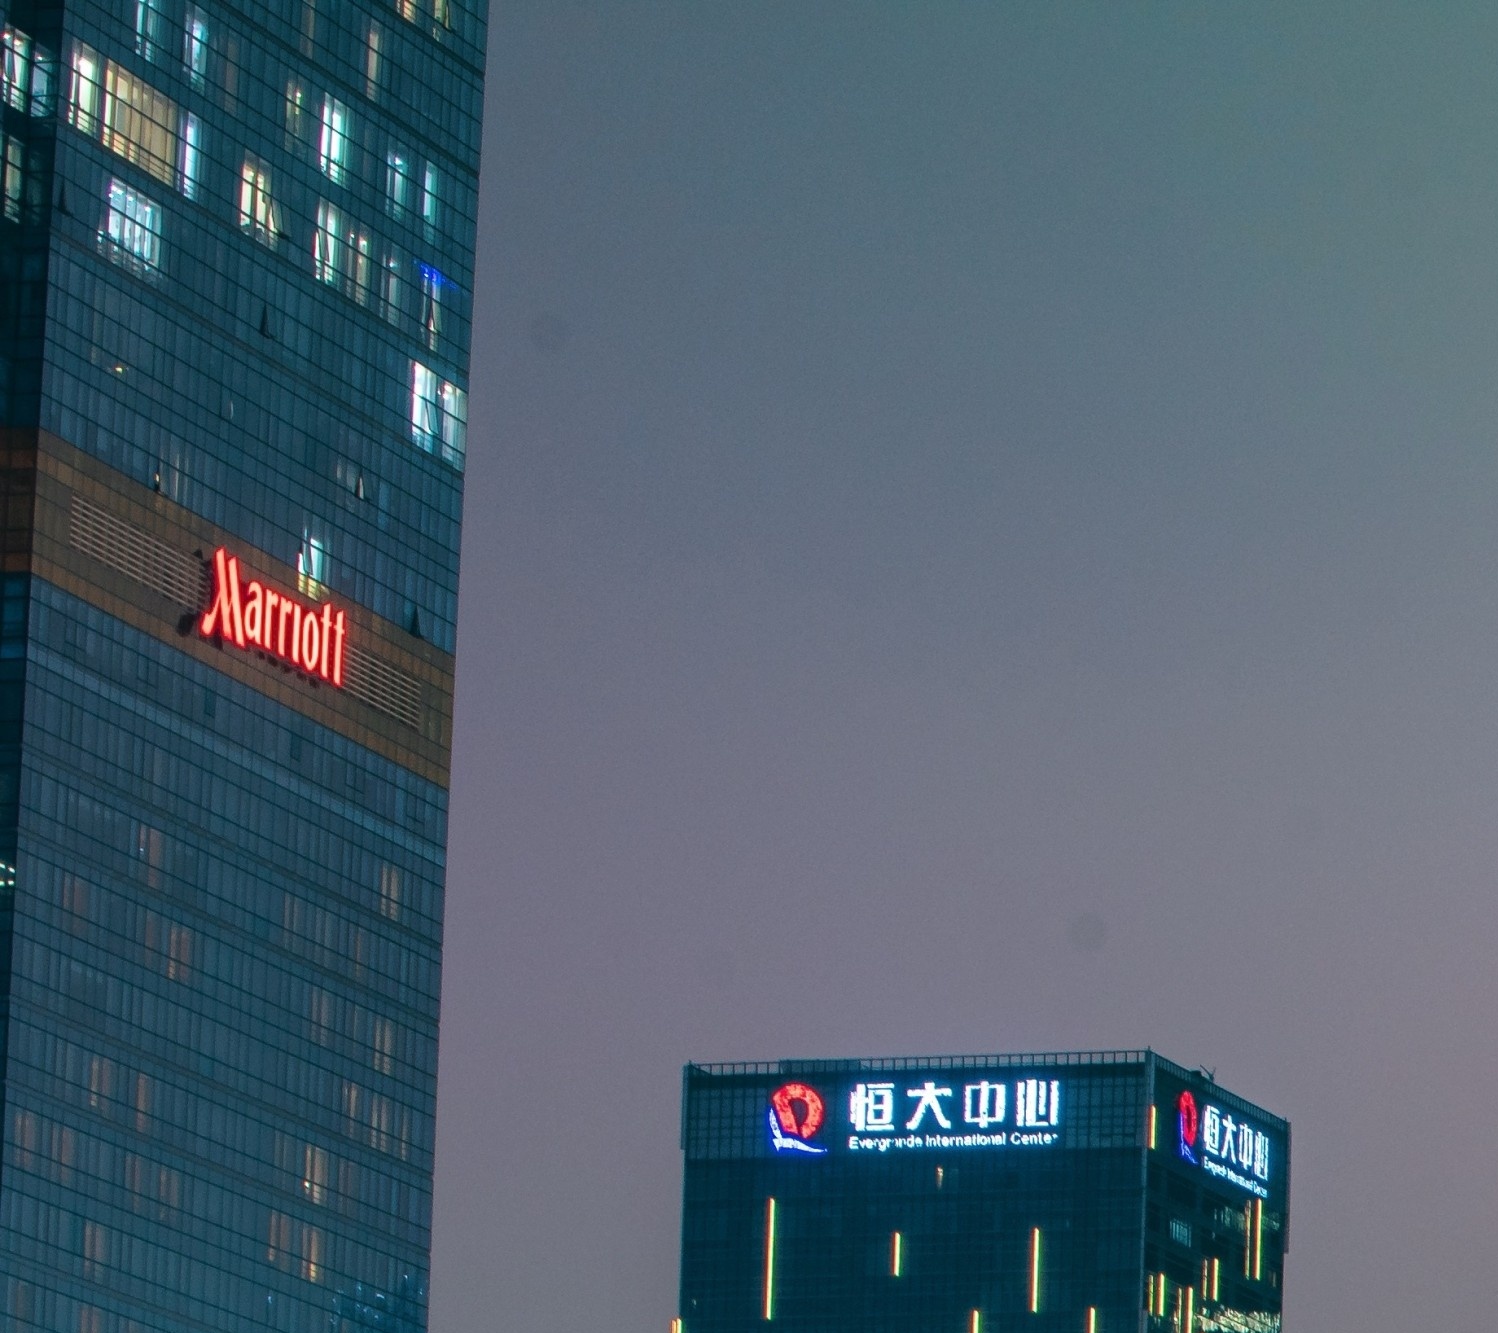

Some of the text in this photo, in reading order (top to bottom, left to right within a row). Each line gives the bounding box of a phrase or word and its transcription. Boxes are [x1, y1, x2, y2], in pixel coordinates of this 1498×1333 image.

[202, 547, 346, 687] Marriott
[850, 1079, 1060, 1131] 恒大中心
[849, 1135, 923, 1152] Evergrande
[926, 1132, 1006, 1148] International
[1204, 1105, 1269, 1181] 恒大中心
